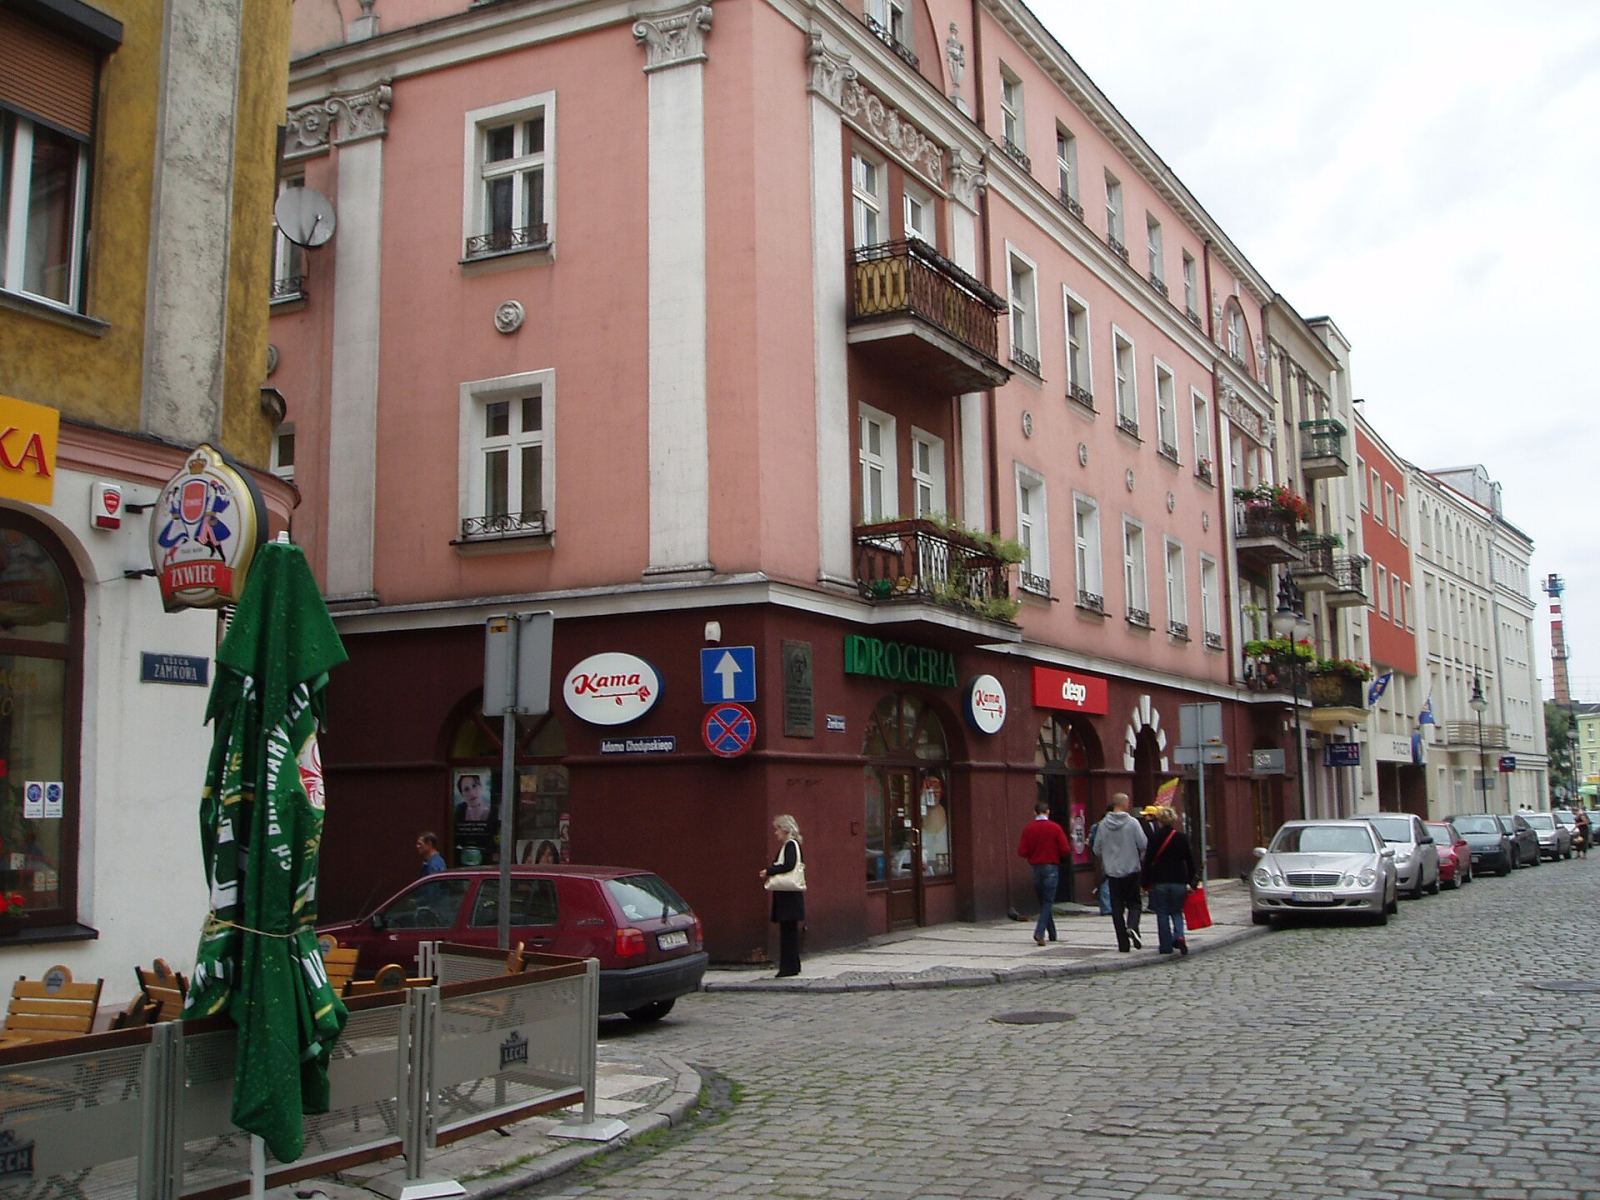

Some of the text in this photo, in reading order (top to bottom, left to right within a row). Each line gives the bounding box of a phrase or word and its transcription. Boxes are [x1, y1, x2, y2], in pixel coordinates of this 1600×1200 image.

[849, 635, 957, 688] DROGERIA
[154, 664, 197, 680] ZAMKOWA
[572, 673, 640, 694] Kama
[975, 690, 999, 706] Kama
